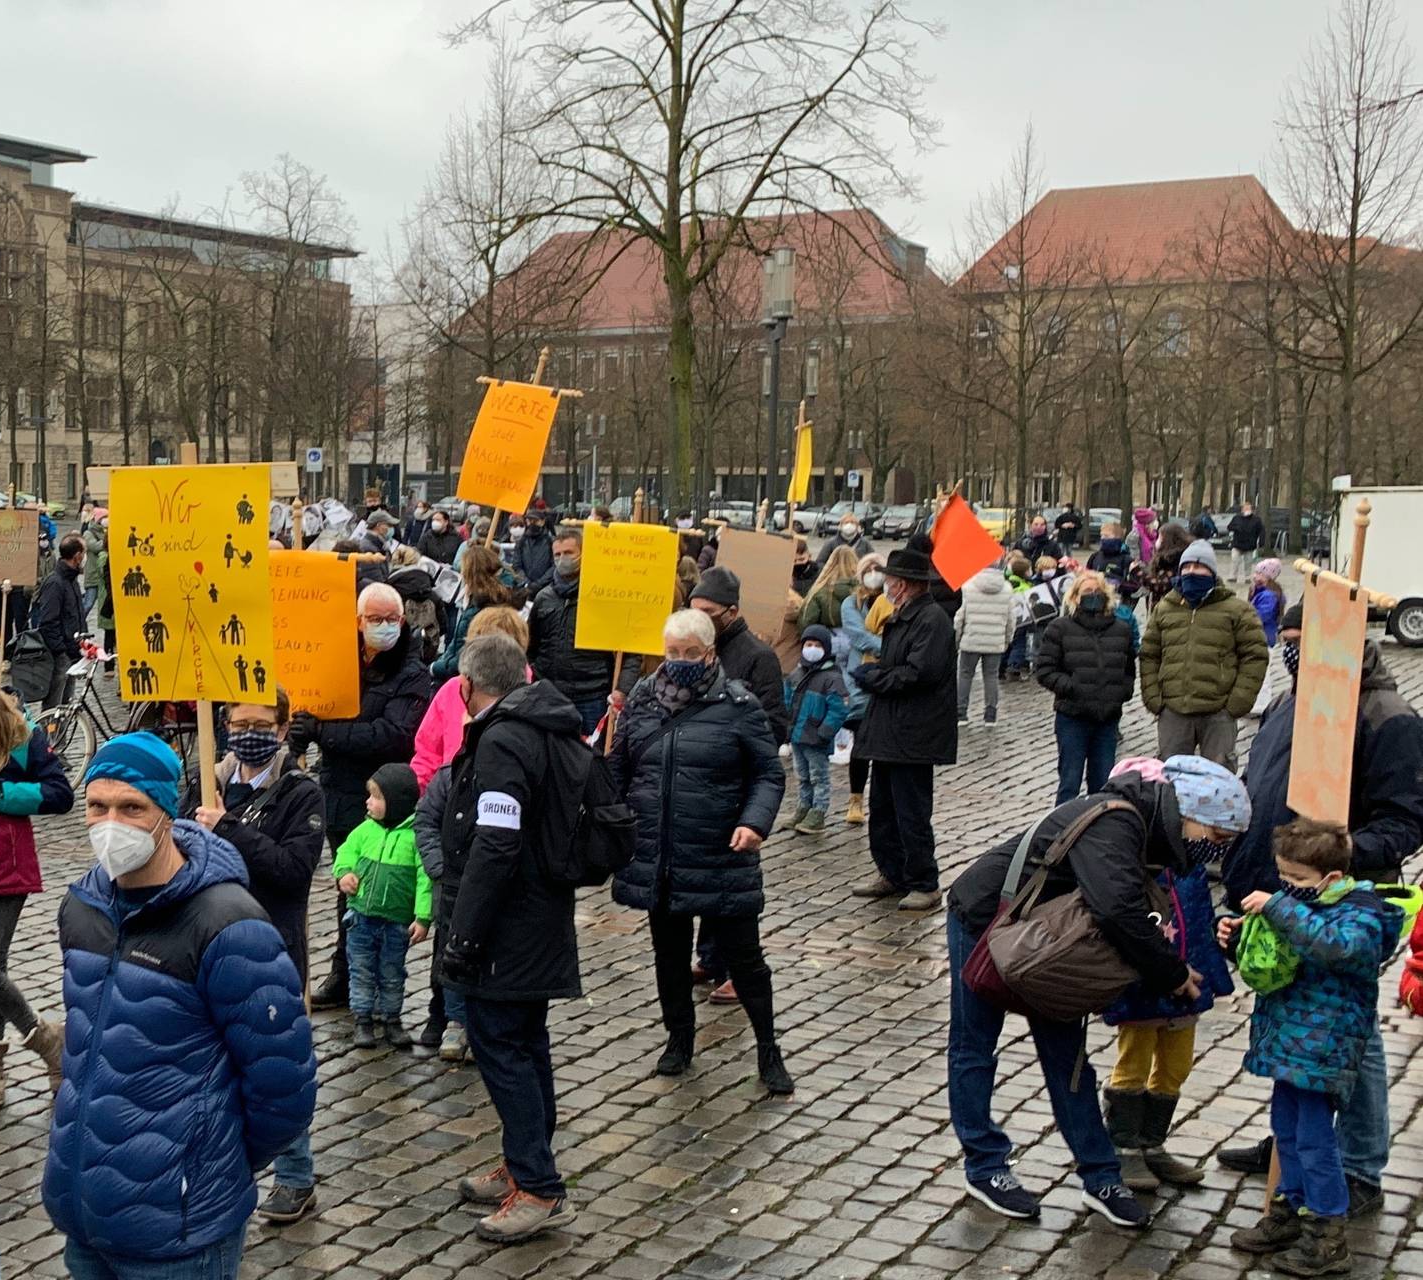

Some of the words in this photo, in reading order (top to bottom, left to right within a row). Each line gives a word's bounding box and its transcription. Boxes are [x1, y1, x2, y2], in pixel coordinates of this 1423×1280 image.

[491, 394, 549, 421] WERTE
[151, 479, 201, 524] Wir
[161, 530, 209, 552] sind
[483, 802, 518, 816] ORDNER
